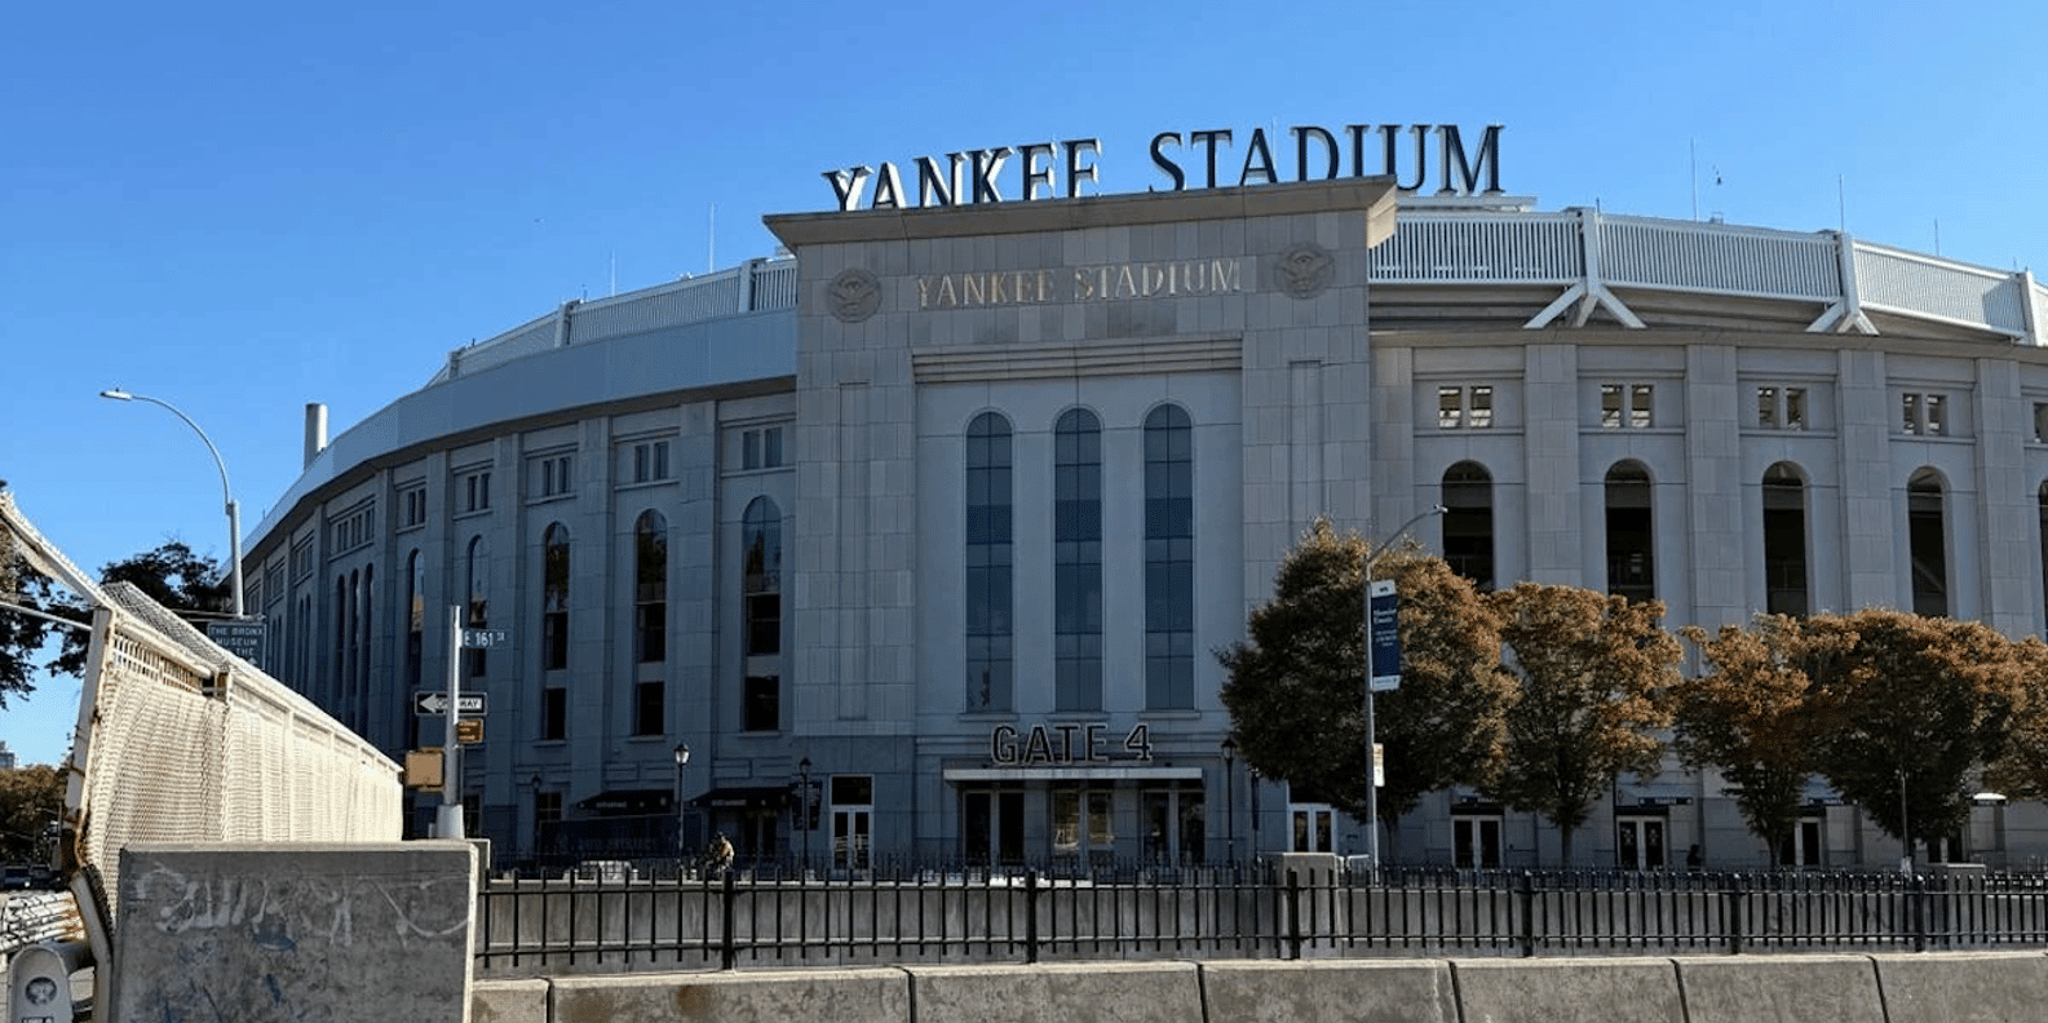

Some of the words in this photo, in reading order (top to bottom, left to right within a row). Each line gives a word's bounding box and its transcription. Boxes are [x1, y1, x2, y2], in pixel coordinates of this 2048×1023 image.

[820, 138, 1102, 211] YANKEE
[1149, 124, 1508, 194] STADIUM
[918, 270, 1054, 311] YANKEE
[1075, 259, 1241, 301] STADIUM
[210, 627, 228, 635] THE
[231, 627, 263, 635] BRONX
[216, 637, 258, 646] MUSEUM
[464, 630, 471, 647] E
[475, 632, 494, 647] 161
[990, 723, 1109, 767] GATE
[1124, 722, 1154, 765] 4
